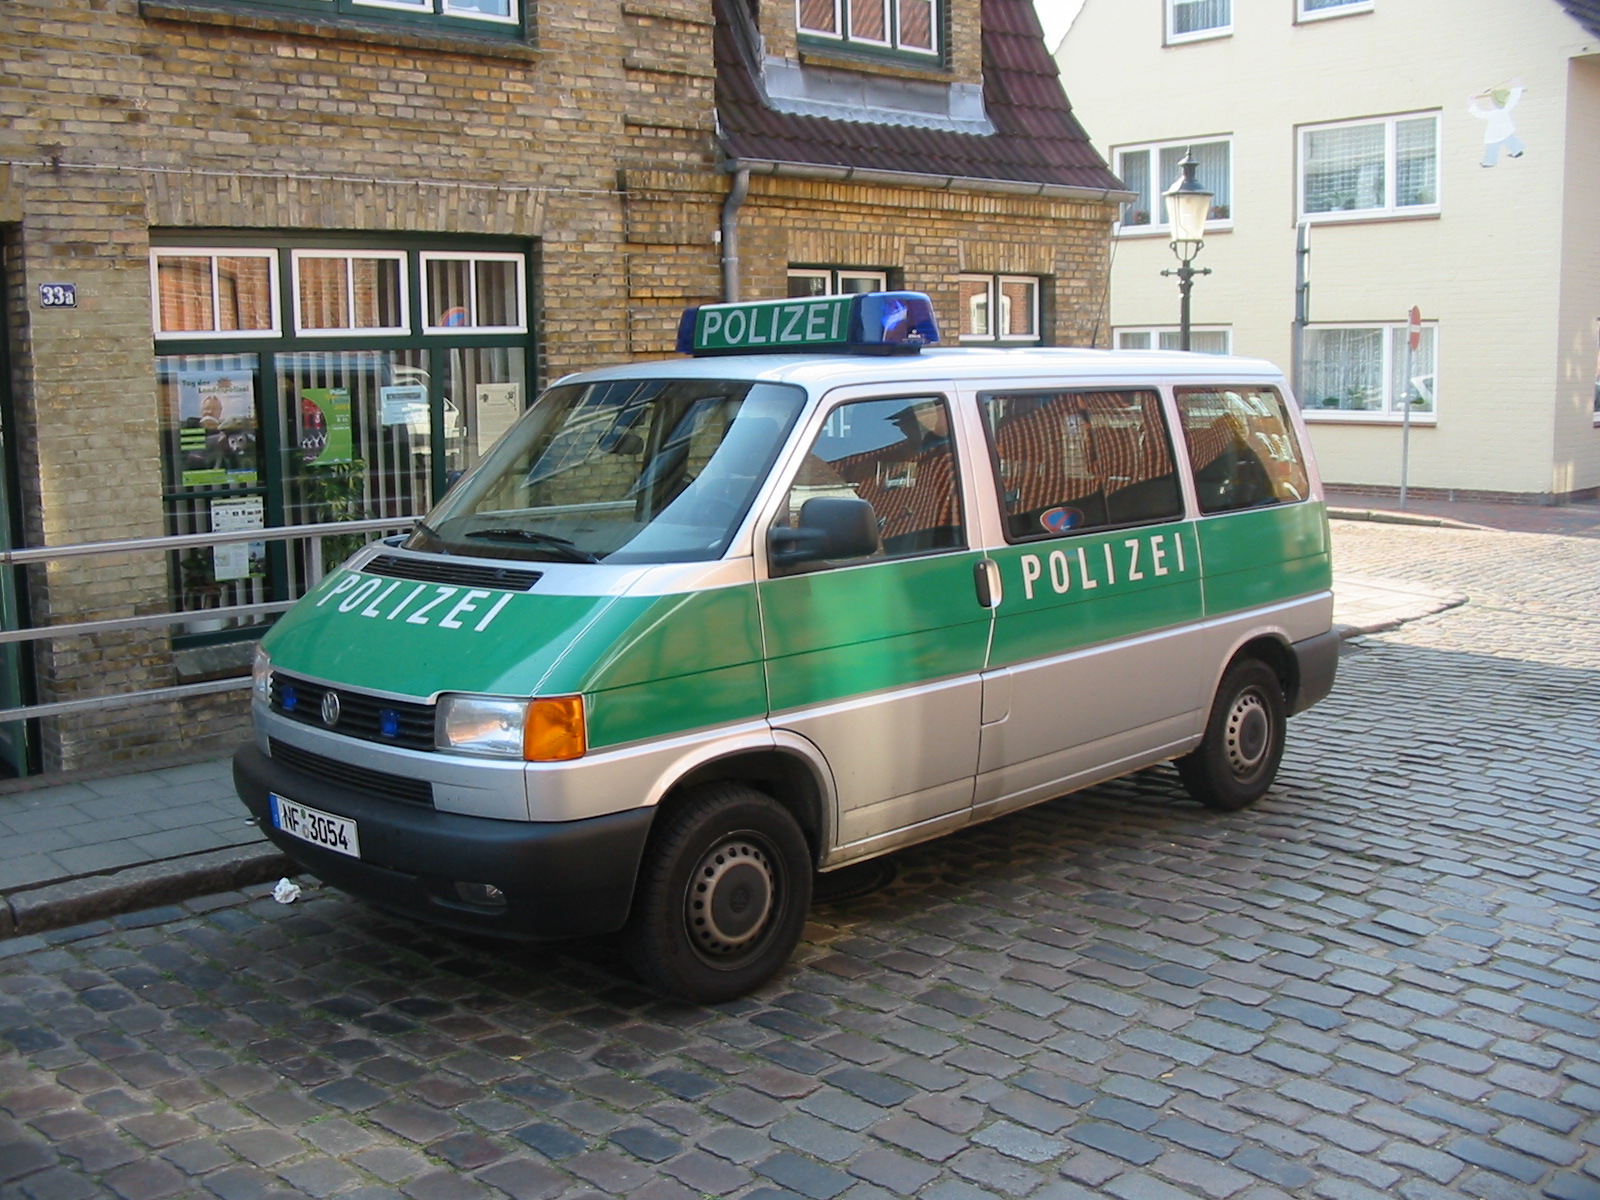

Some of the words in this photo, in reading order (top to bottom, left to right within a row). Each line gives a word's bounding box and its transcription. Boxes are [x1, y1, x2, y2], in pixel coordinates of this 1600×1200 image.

[42, 286, 74, 304] 33a
[702, 302, 842, 345] POLIZEI
[1020, 532, 1185, 600] POLIZEI
[316, 574, 515, 632] POLIZEI
[283, 804, 299, 831] NF
[308, 813, 348, 850] 3054
